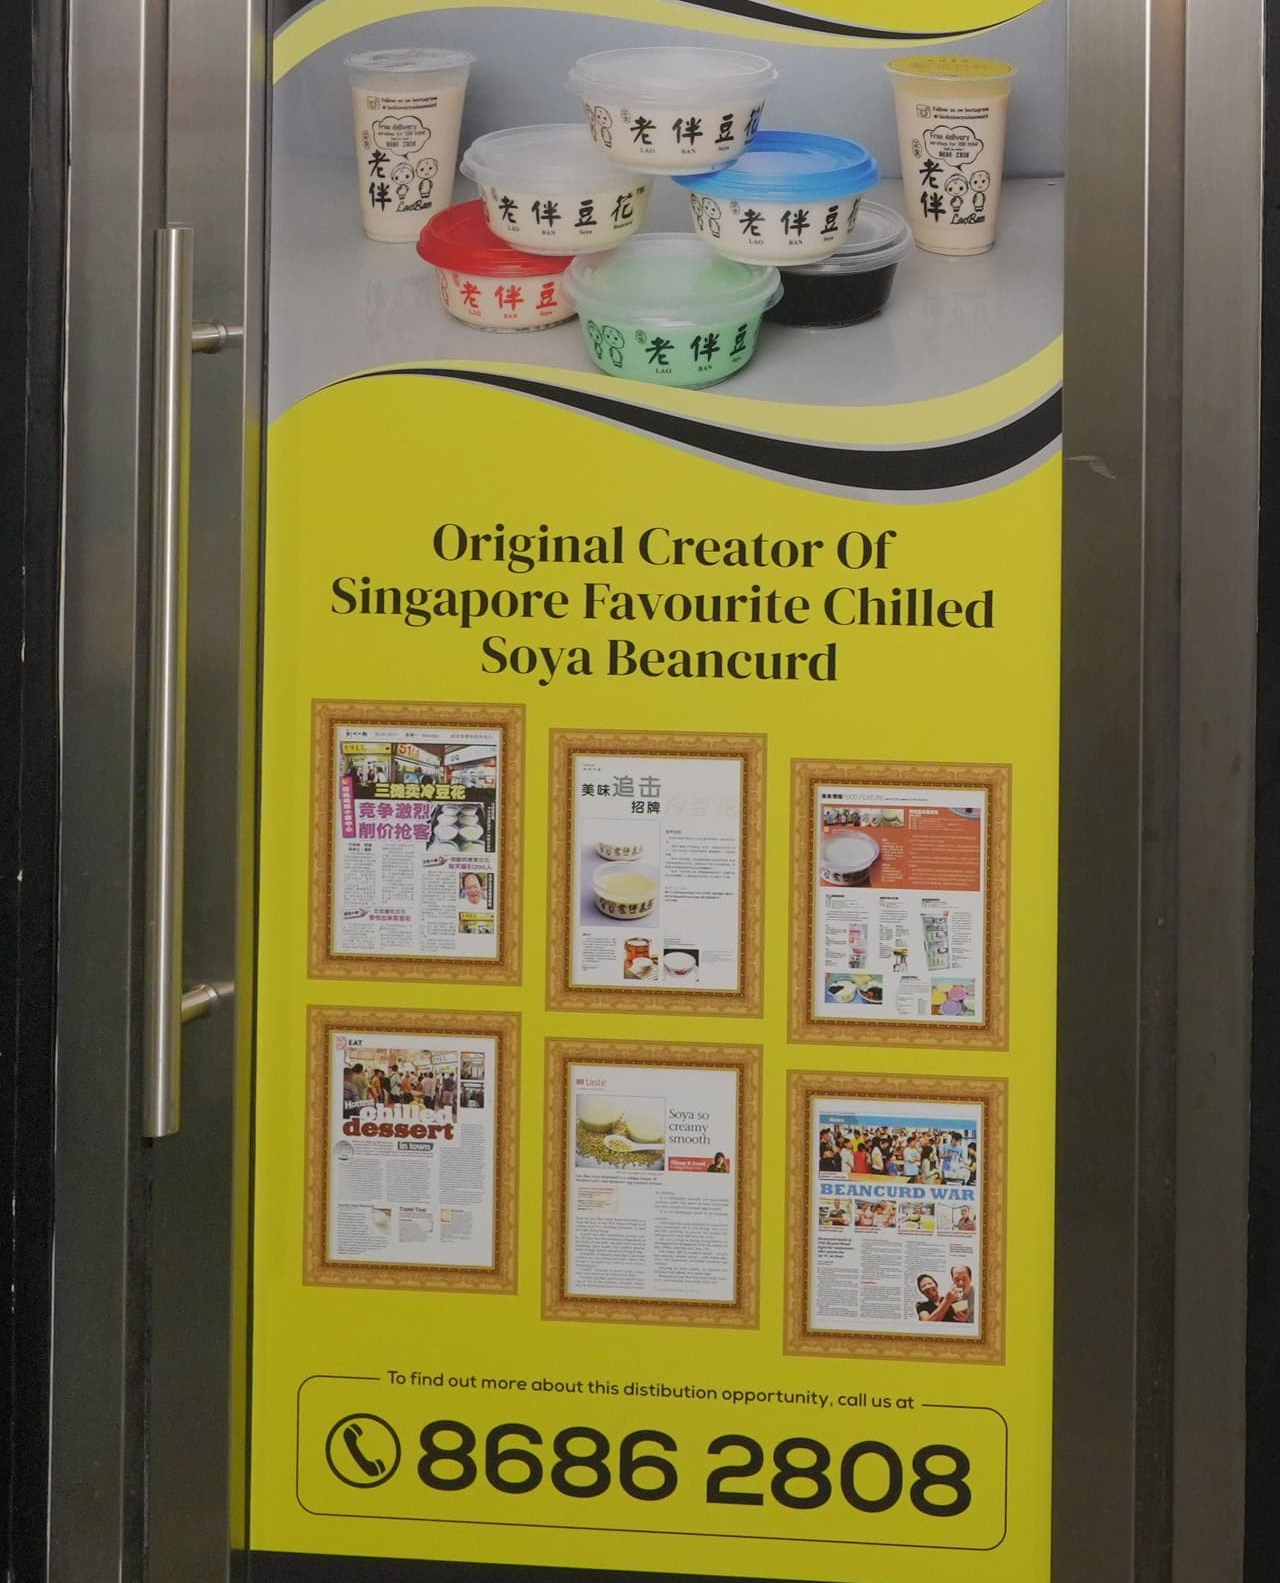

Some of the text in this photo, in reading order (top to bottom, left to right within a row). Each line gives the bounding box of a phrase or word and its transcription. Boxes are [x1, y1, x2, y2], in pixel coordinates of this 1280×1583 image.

[368, 149, 392, 212] 老伴
[919, 159, 946, 223] 老伴
[499, 192, 633, 228] 老伴豆花
[434, 524, 897, 573] Original Creator Of
[332, 577, 993, 628] Singapore Favourite Chilled
[482, 637, 836, 686] Soya Beancurd
[581, 775, 661, 798] 美味追击
[359, 802, 431, 819] 竞争激烈
[632, 801, 661, 815] 招牌
[359, 822, 432, 840] 削价抢客
[669, 1108, 709, 1120] Soya so
[343, 1117, 454, 1140] dessert
[669, 1123, 709, 1133] creamy
[669, 1134, 711, 1145] smooth
[820, 1183, 975, 1201] BEANCURD WAR
[388, 1370, 914, 1409] To find out more about this distibution opportunity, call us at
[418, 1420, 971, 1517] 8686 2808
